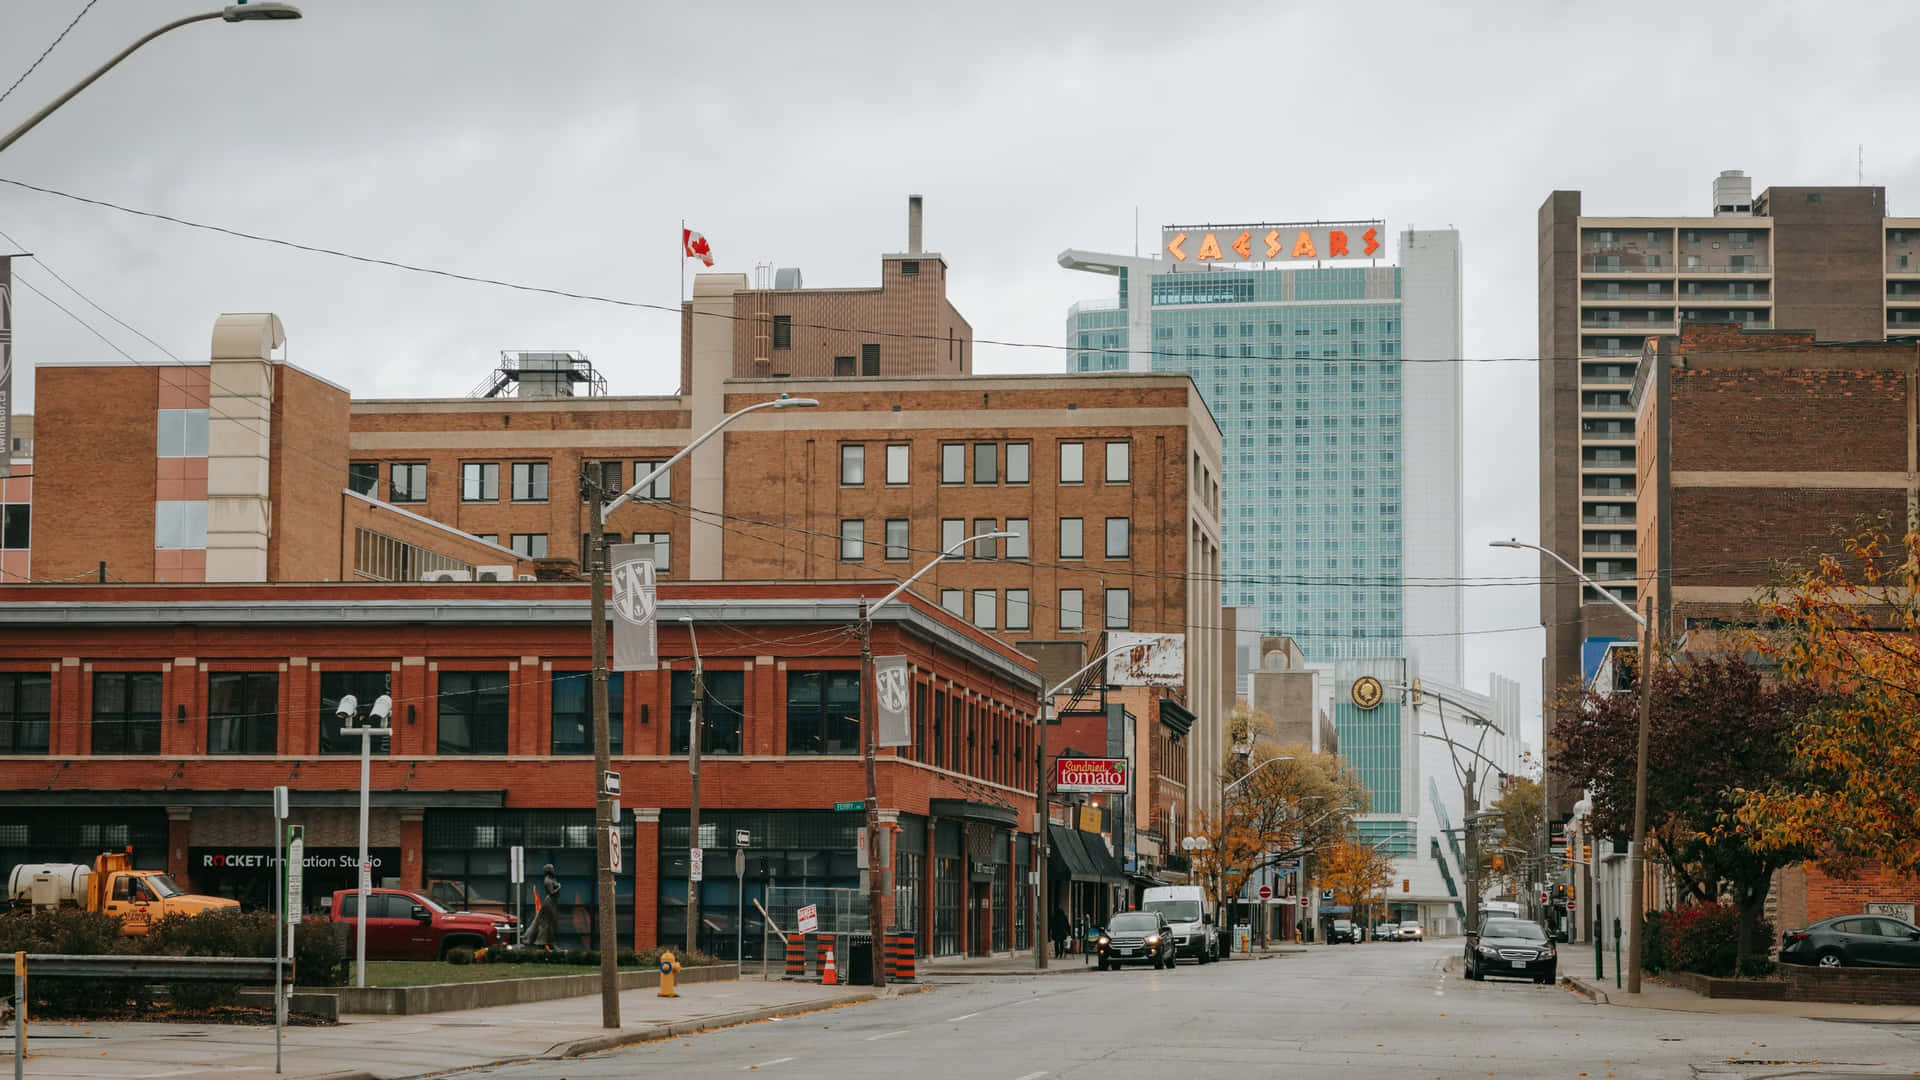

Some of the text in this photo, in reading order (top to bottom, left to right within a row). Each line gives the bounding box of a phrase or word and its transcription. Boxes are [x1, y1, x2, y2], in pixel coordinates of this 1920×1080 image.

[1167, 226, 1380, 262] CAESARS
[1065, 760, 1105, 773] Sundried
[1062, 769, 1122, 785] tomato
[203, 855, 382, 868] ROCKET Innation Stuio
